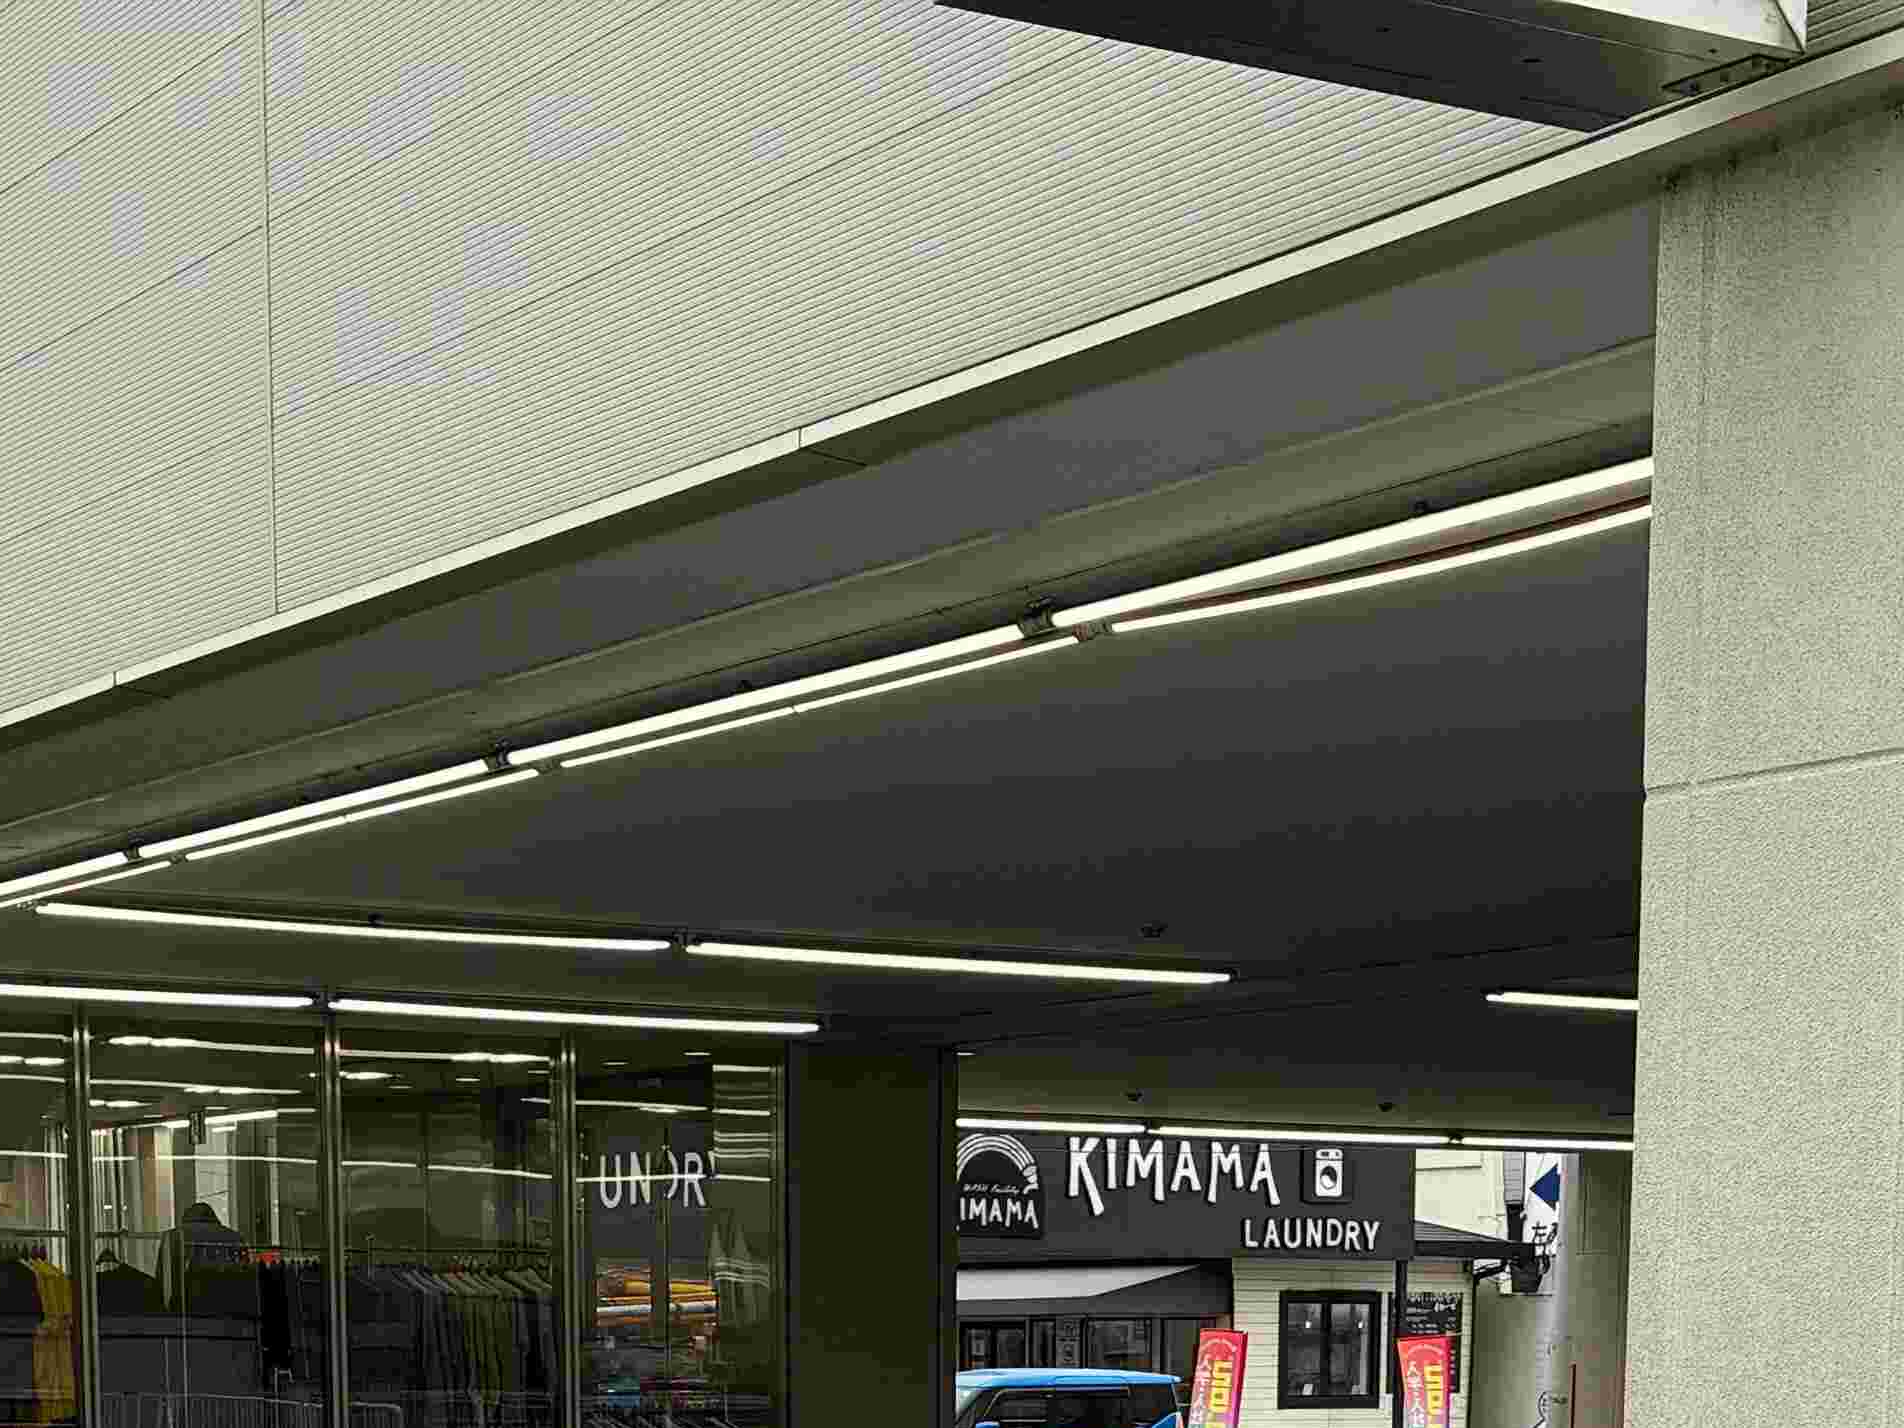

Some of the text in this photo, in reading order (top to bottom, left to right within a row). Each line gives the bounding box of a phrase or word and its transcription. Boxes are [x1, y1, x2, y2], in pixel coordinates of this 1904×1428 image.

[1067, 1136, 1280, 1217] KIMAMA
[957, 1197, 1039, 1229] IMAMA
[1244, 1218, 1380, 1251] LAUNDRY
